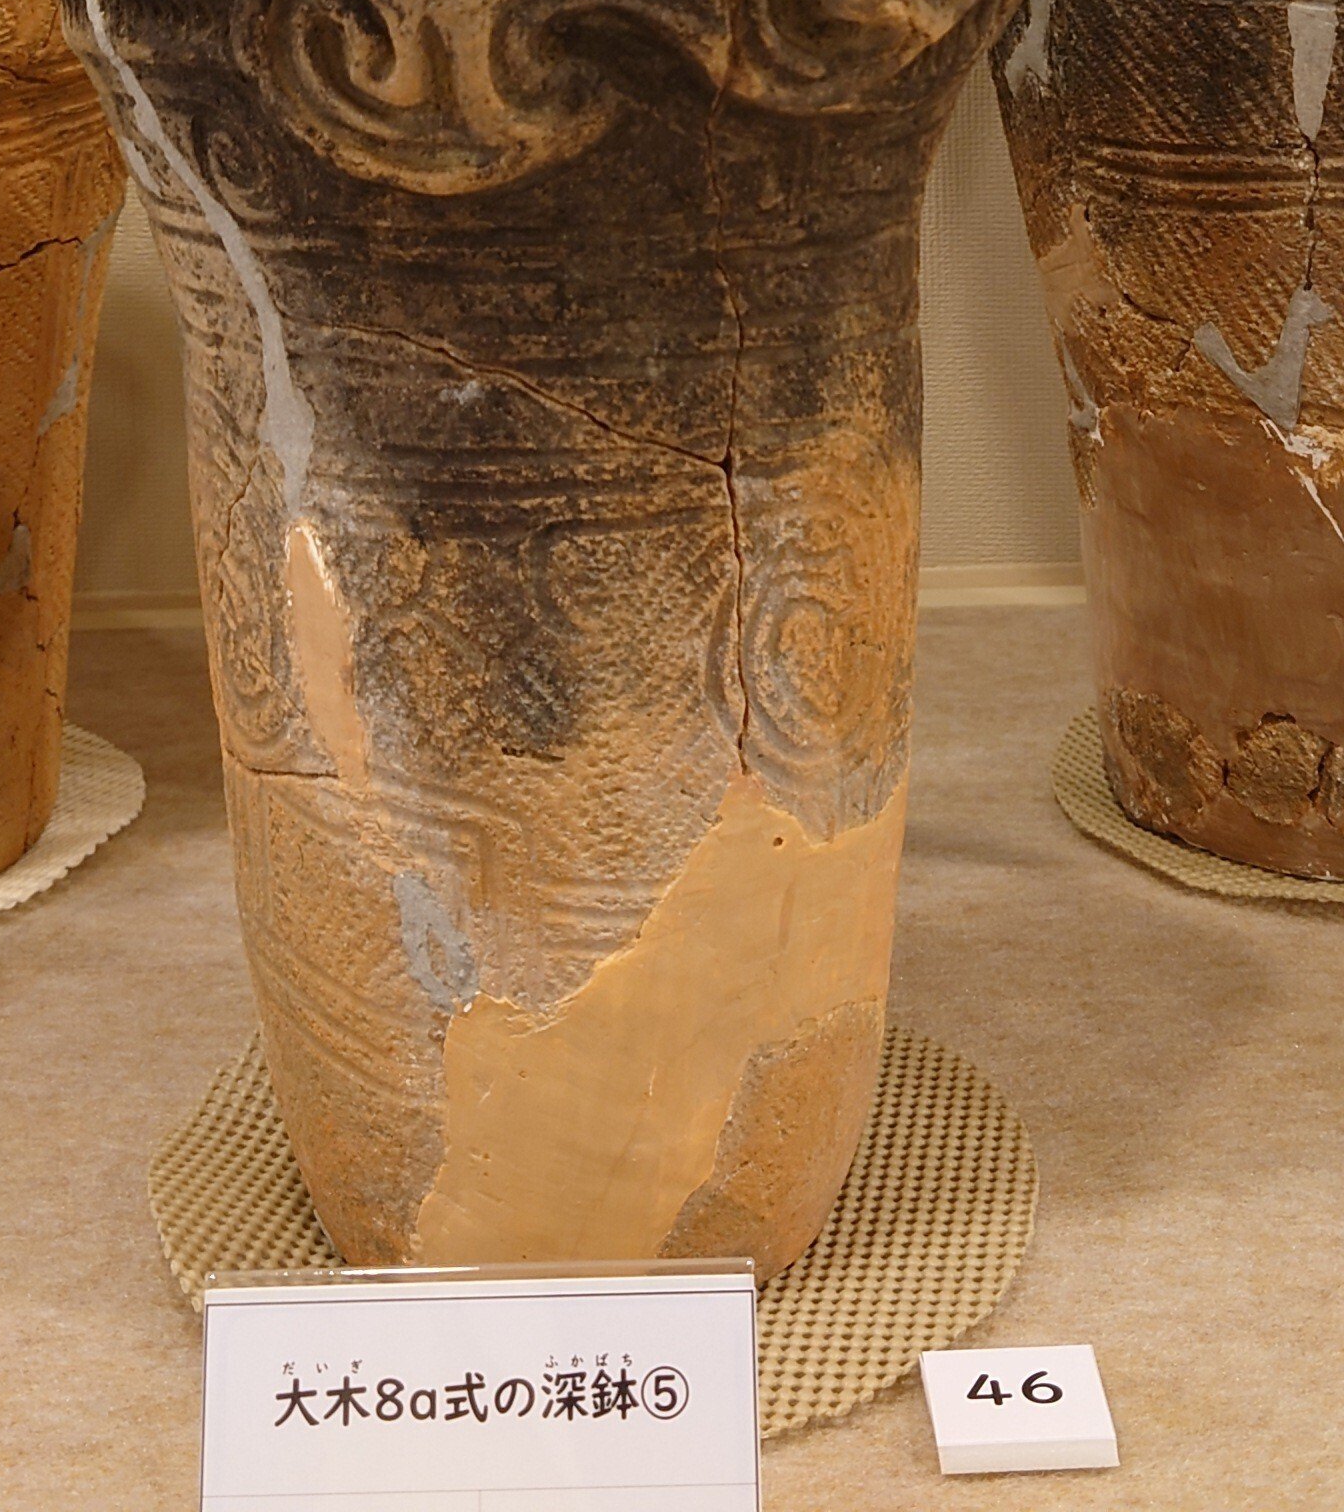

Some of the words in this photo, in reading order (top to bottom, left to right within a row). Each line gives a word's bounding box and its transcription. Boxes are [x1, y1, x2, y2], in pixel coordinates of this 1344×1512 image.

[272, 1364, 690, 1430] 大木8a式の深鉢⑤
[965, 1371, 1065, 1407] 46
